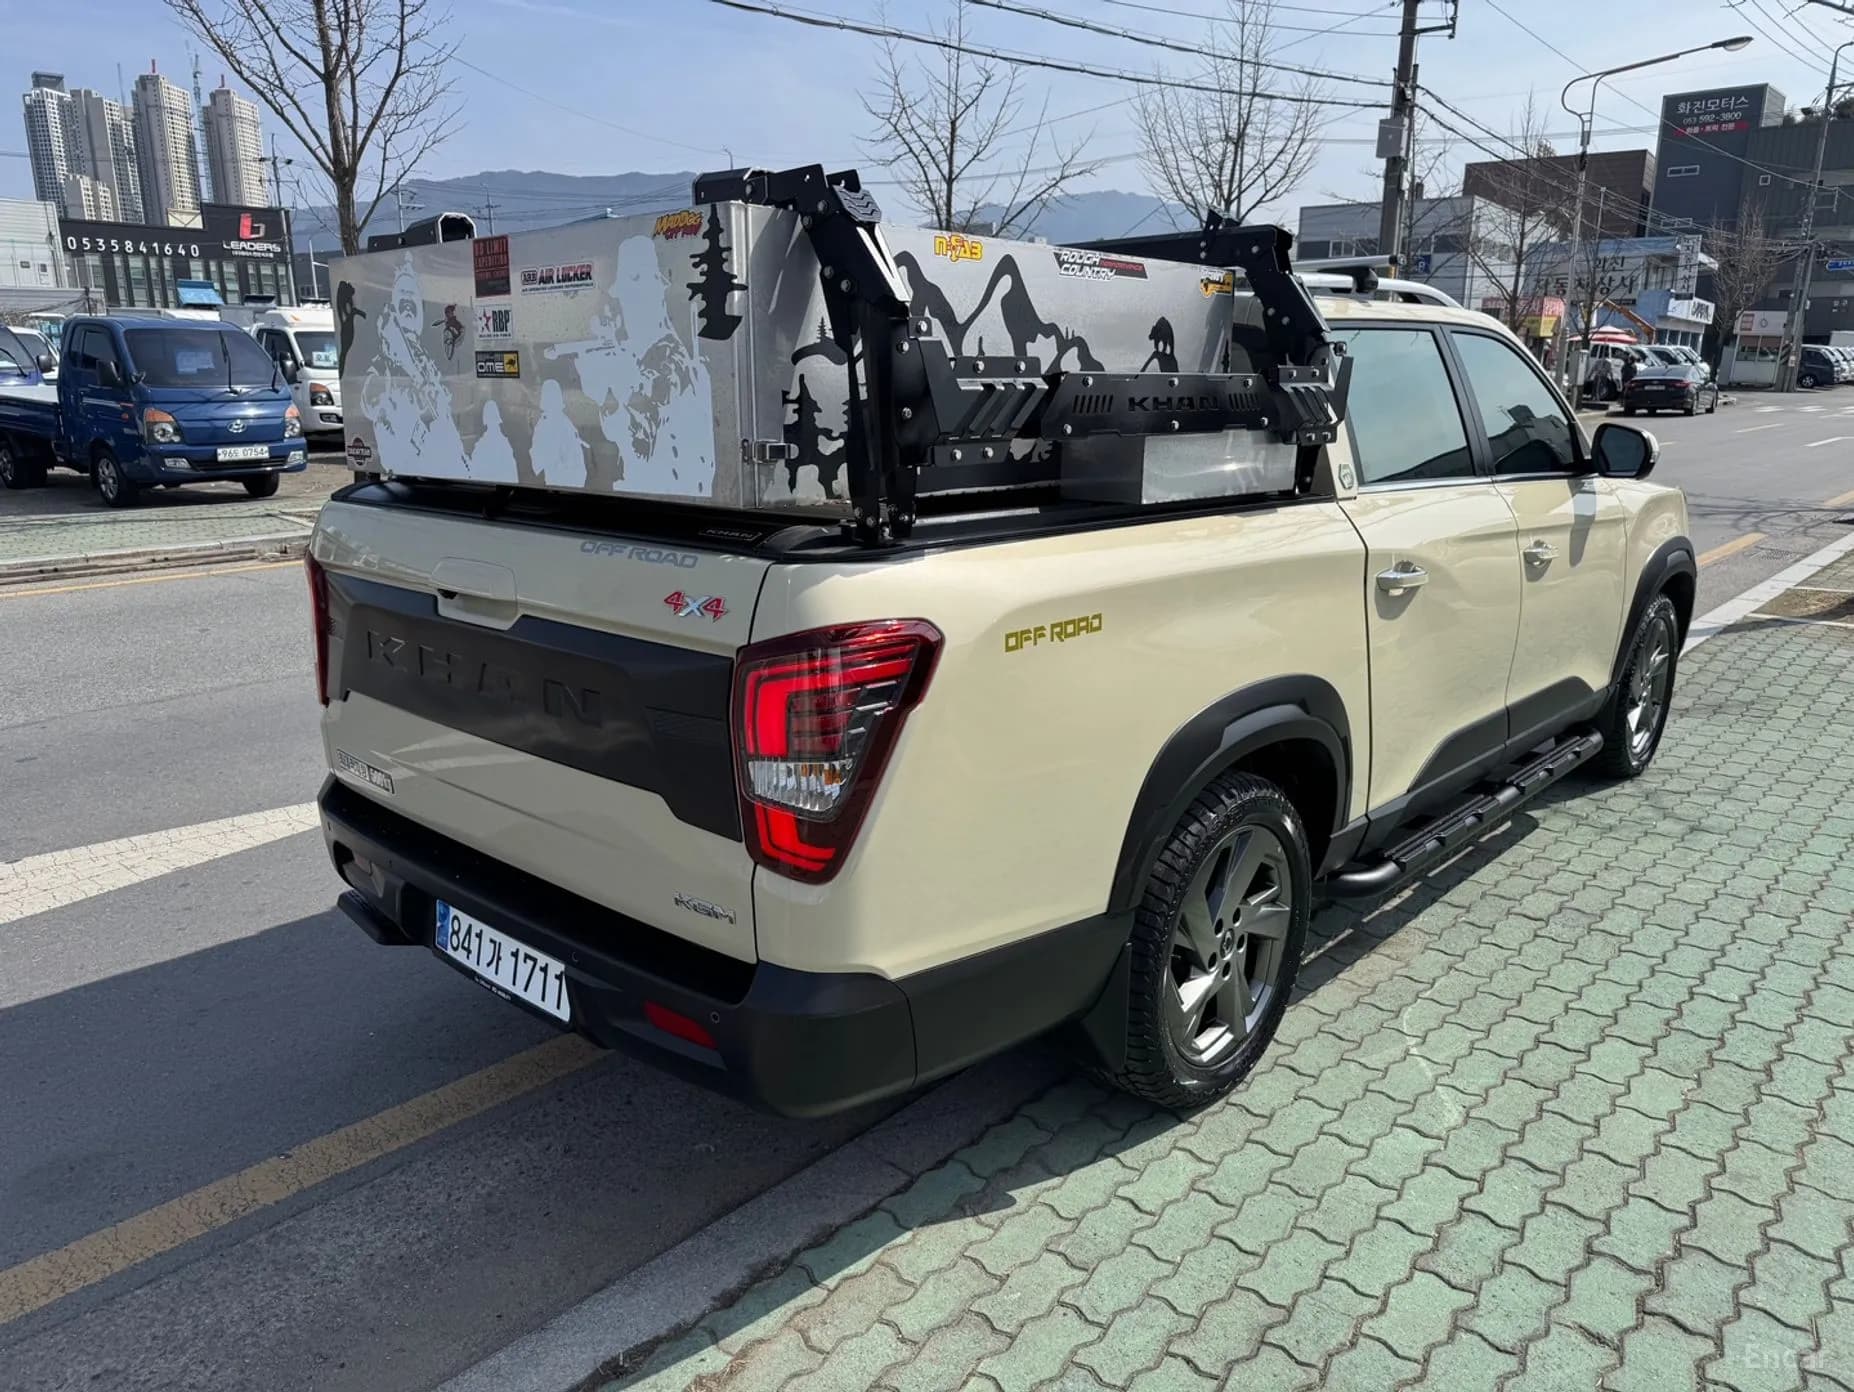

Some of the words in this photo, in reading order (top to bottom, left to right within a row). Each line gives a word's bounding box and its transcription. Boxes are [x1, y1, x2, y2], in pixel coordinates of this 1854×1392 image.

[1677, 96, 1749, 114] 화진모터스
[67, 236, 200, 257] 0535841640
[222, 240, 281, 252] LEADERS
[1059, 250, 1101, 265] ROUGH
[538, 267, 555, 285] AIR
[1060, 263, 1117, 279] COUNTRY
[492, 310, 511, 332] RBP
[1128, 396, 1219, 411] KHAN
[580, 540, 627, 557] OFF
[628, 546, 699, 569] ROAD
[1005, 625, 1047, 653] OFF
[1050, 613, 1102, 642] ROAD
[366, 627, 603, 729] KHAN
[674, 891, 737, 926] KGM
[449, 914, 503, 976] 841가
[510, 947, 565, 1011] 1711
